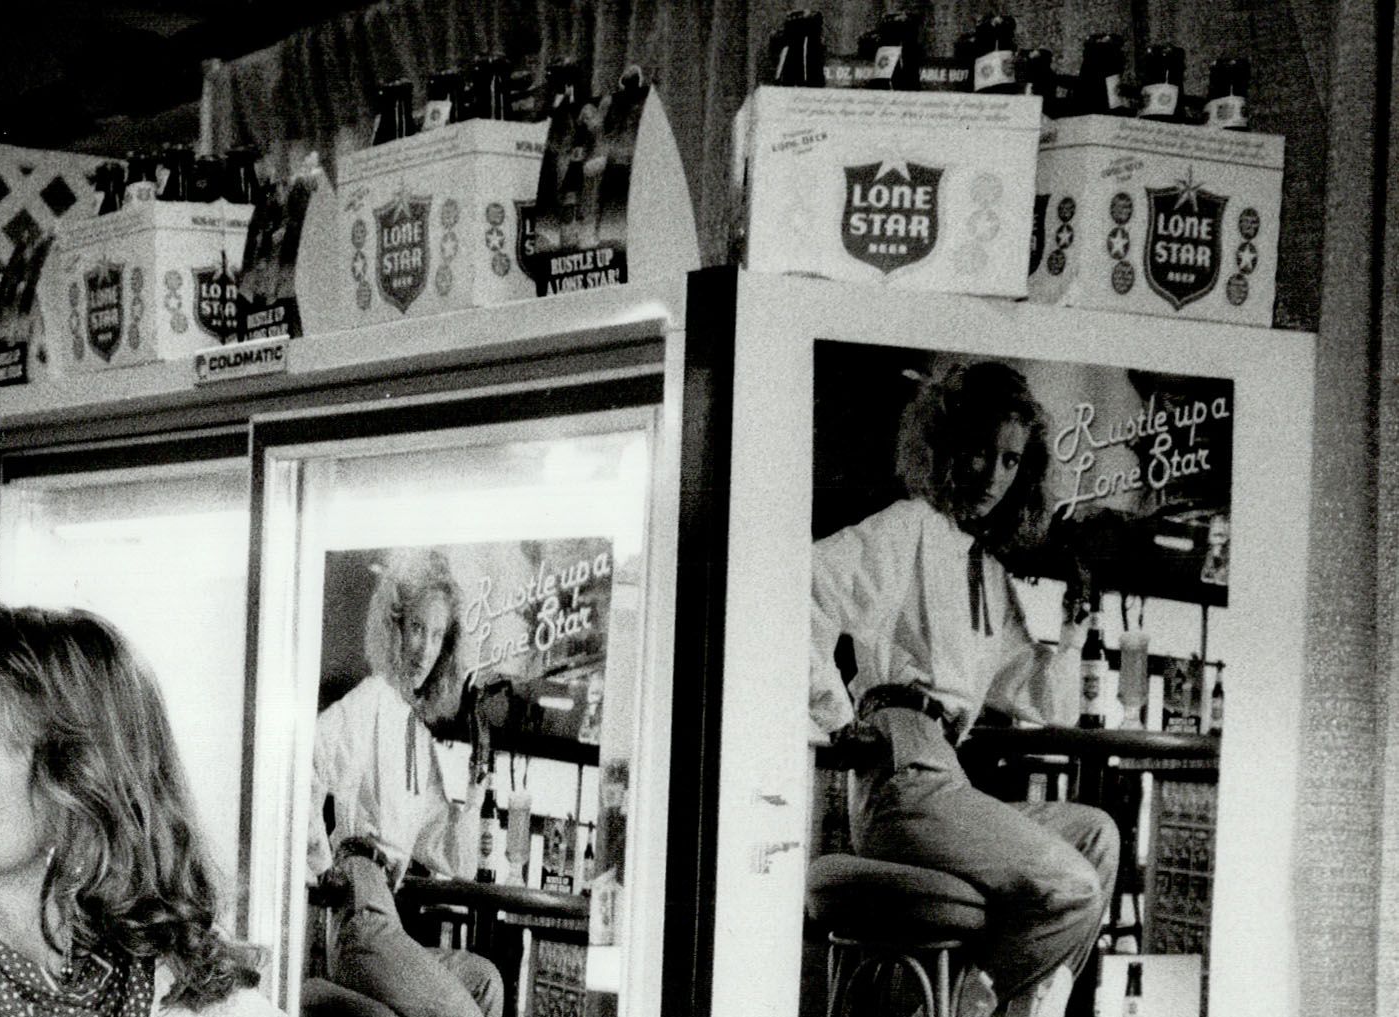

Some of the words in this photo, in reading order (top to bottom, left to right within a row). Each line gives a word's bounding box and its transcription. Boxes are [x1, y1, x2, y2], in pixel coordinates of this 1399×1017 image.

[852, 183, 933, 210] LONE
[382, 220, 424, 247] LONE
[849, 212, 930, 239] STAR
[1157, 212, 1213, 240] LONE
[382, 247, 423, 274] STAR
[550, 250, 594, 276] RUSTLE
[596, 247, 614, 268] UP
[1154, 240, 1212, 268] STAR
[201, 282, 239, 301] LON
[555, 273, 585, 294] LONE
[200, 299, 238, 318] STA
[208, 346, 284, 371] COLDMATIC
[1054, 394, 1169, 463] Rustle
[1174, 400, 1208, 447] up
[1211, 397, 1230, 419] a
[1054, 451, 1144, 521] Lone
[1147, 432, 1211, 489] Star
[464, 561, 557, 634] Rustle
[560, 560, 590, 608] up
[593, 552, 611, 578] a
[464, 622, 530, 692] Lone
[534, 595, 592, 651] Star
